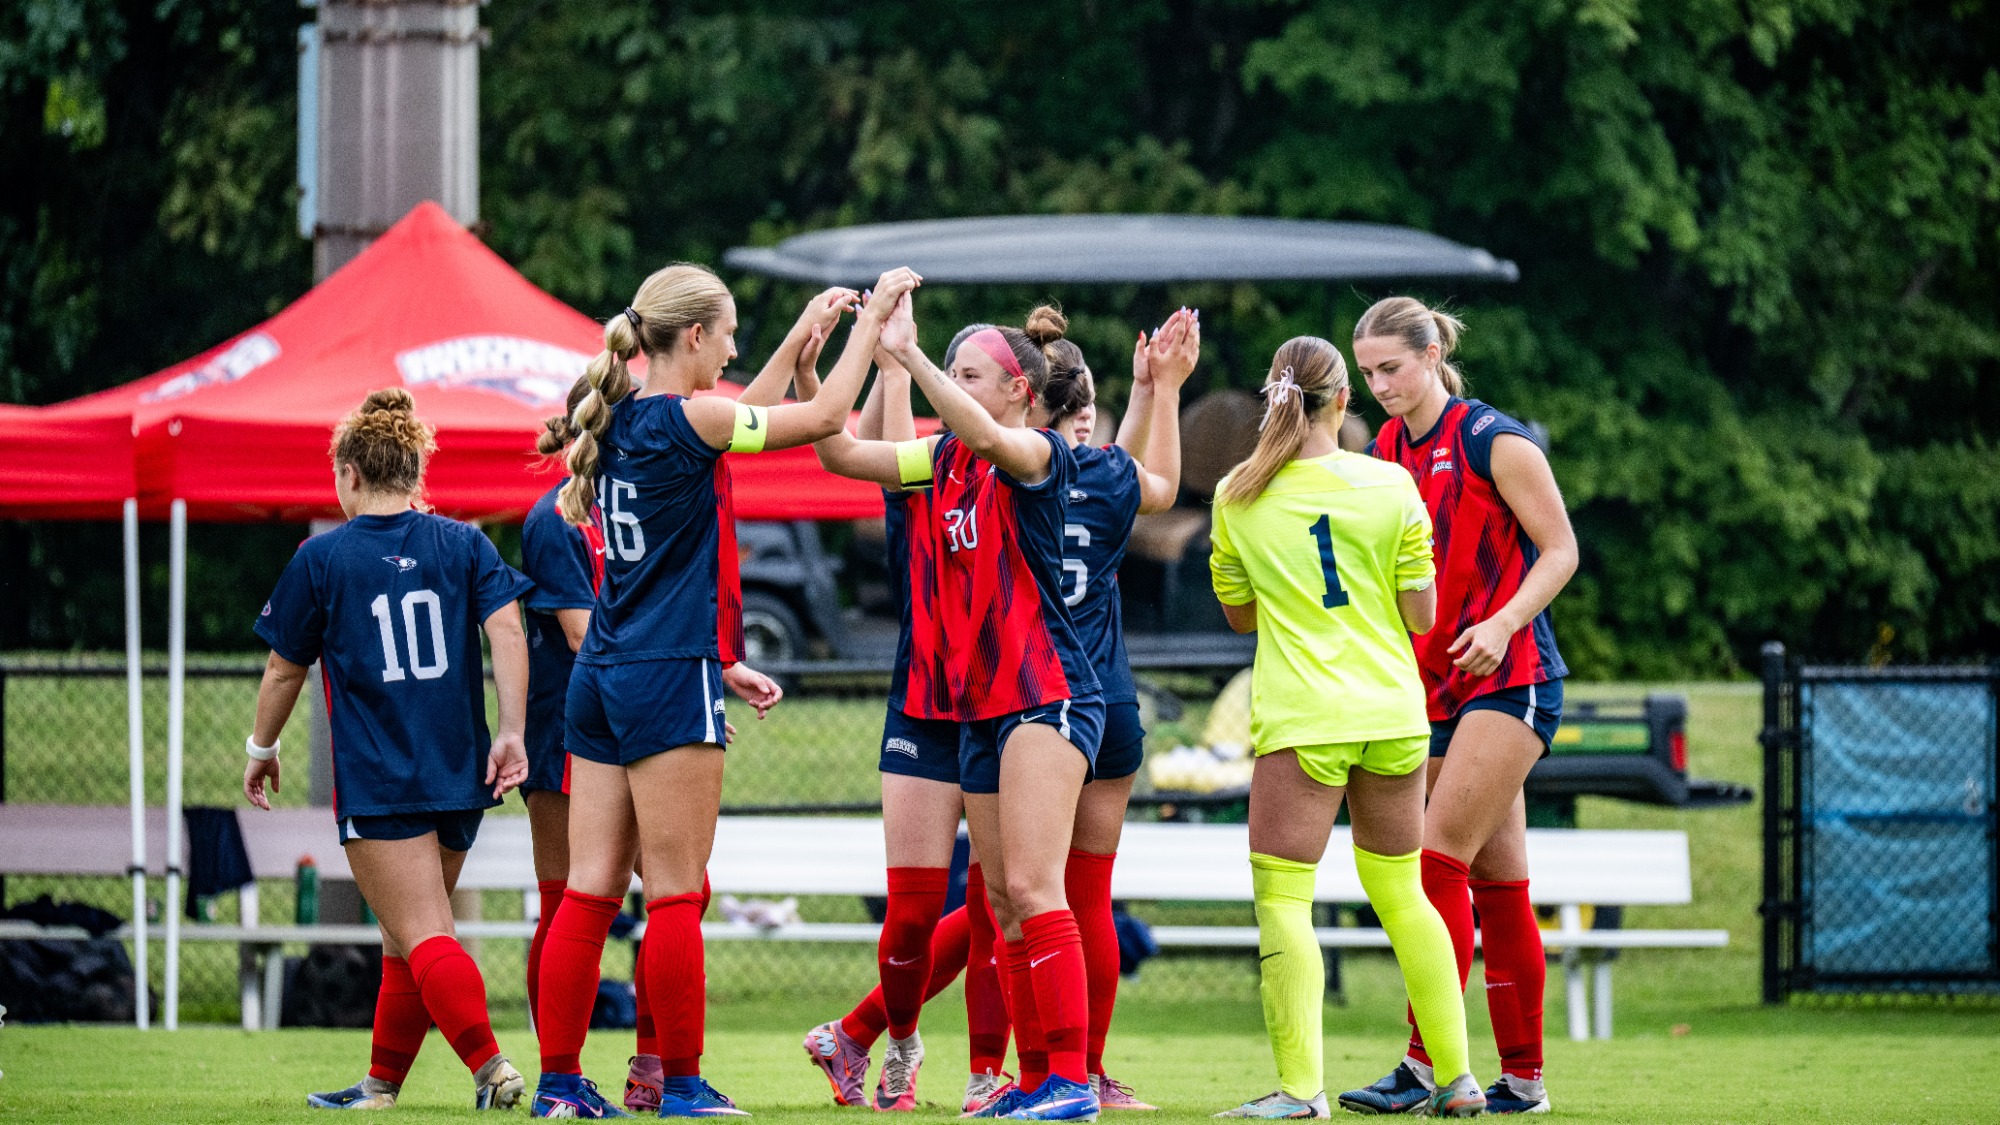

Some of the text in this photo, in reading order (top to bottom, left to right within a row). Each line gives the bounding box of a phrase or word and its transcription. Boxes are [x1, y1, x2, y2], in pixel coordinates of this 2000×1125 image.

[598, 474, 646, 562] 16
[944, 504, 979, 552] 30
[1309, 514, 1350, 609] 1
[371, 589, 449, 682] 10
